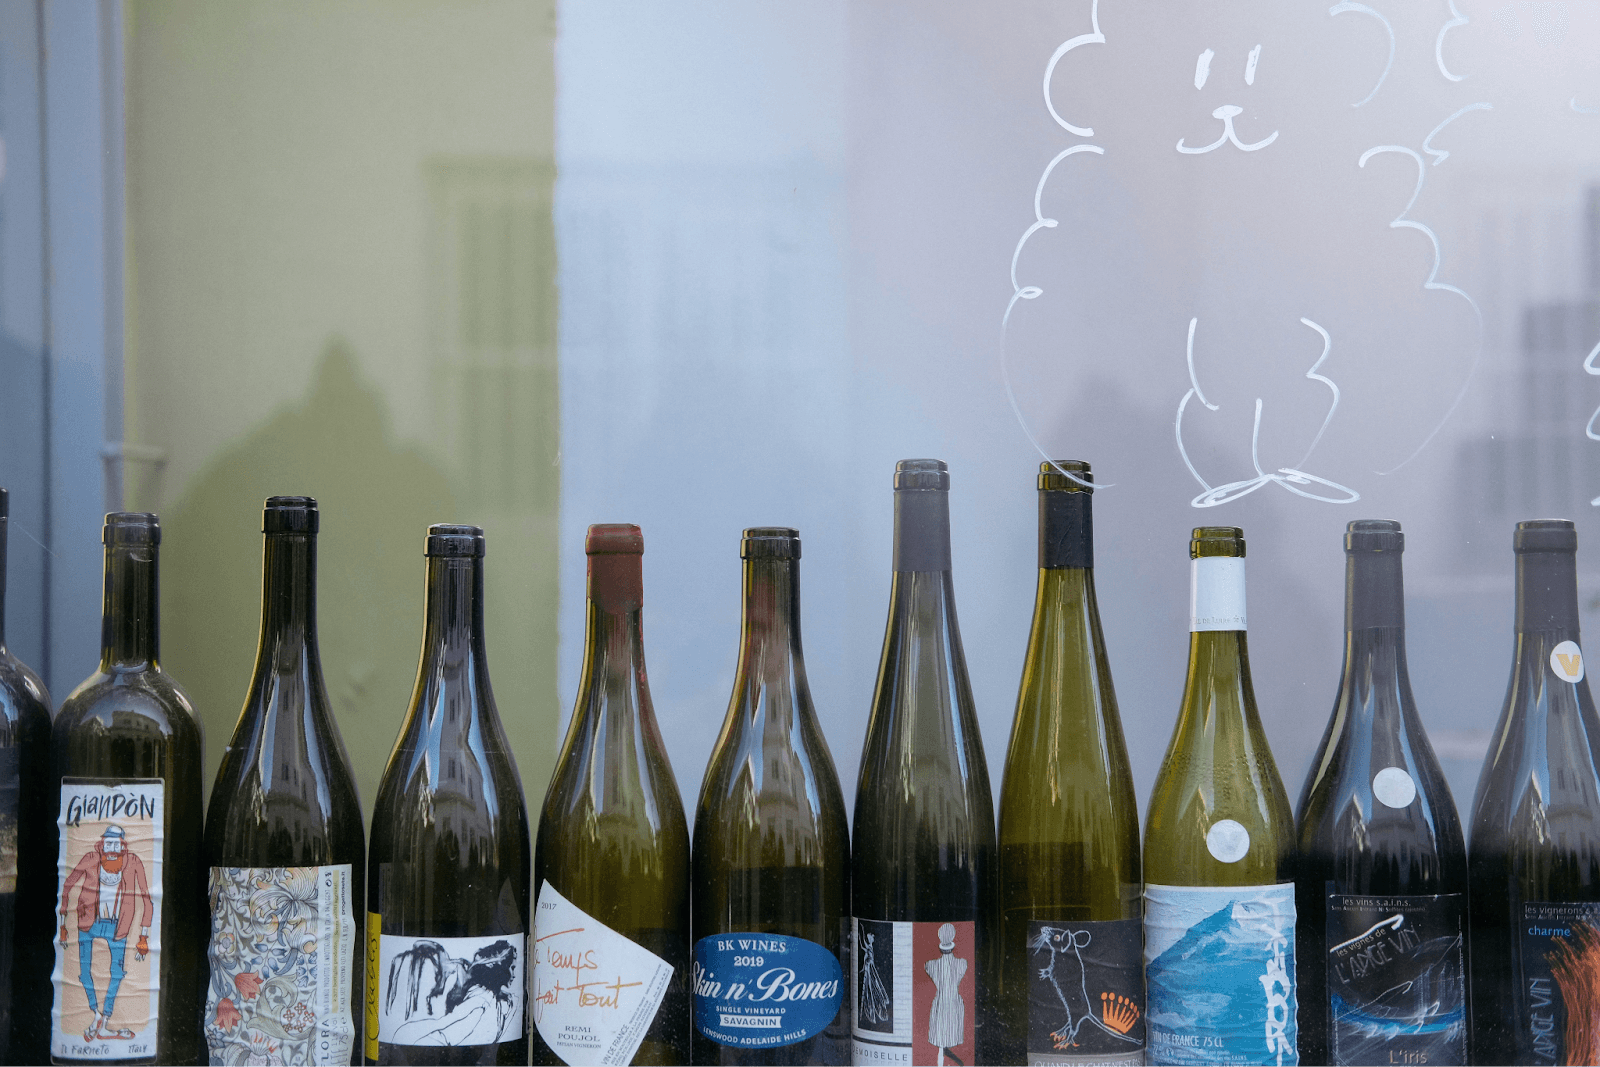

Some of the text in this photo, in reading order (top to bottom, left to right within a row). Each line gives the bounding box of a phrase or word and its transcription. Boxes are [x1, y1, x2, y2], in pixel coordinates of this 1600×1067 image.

[541, 902, 557, 910] 2017
[1342, 897, 1354, 906] les
[1356, 897, 1374, 906] vins
[1525, 904, 1537, 914] les
[1375, 928, 1387, 937] de
[1528, 924, 1571, 937] charme
[718, 940, 786, 953] BK WINES
[733, 956, 764, 967] 2019
[692, 961, 724, 999] Skin
[749, 967, 839, 1002] Bones
[715, 1005, 742, 1014] SINGLE
[723, 1016, 777, 1026] SAVAGNIN
[565, 1025, 591, 1033] REMI
[558, 1033, 600, 1042] POUJOL
[740, 1036, 782, 1045] ADELAIDE
[784, 1028, 807, 1041] HILLS
[1172, 1034, 1199, 1047] FRANCE
[1203, 1036, 1213, 1047] 75
[1214, 1037, 1224, 1047] CL
[601, 1053, 611, 1065] VIN
[612, 1024, 629, 1047] FRANCE
[1390, 1050, 1427, 1063] L'iris
